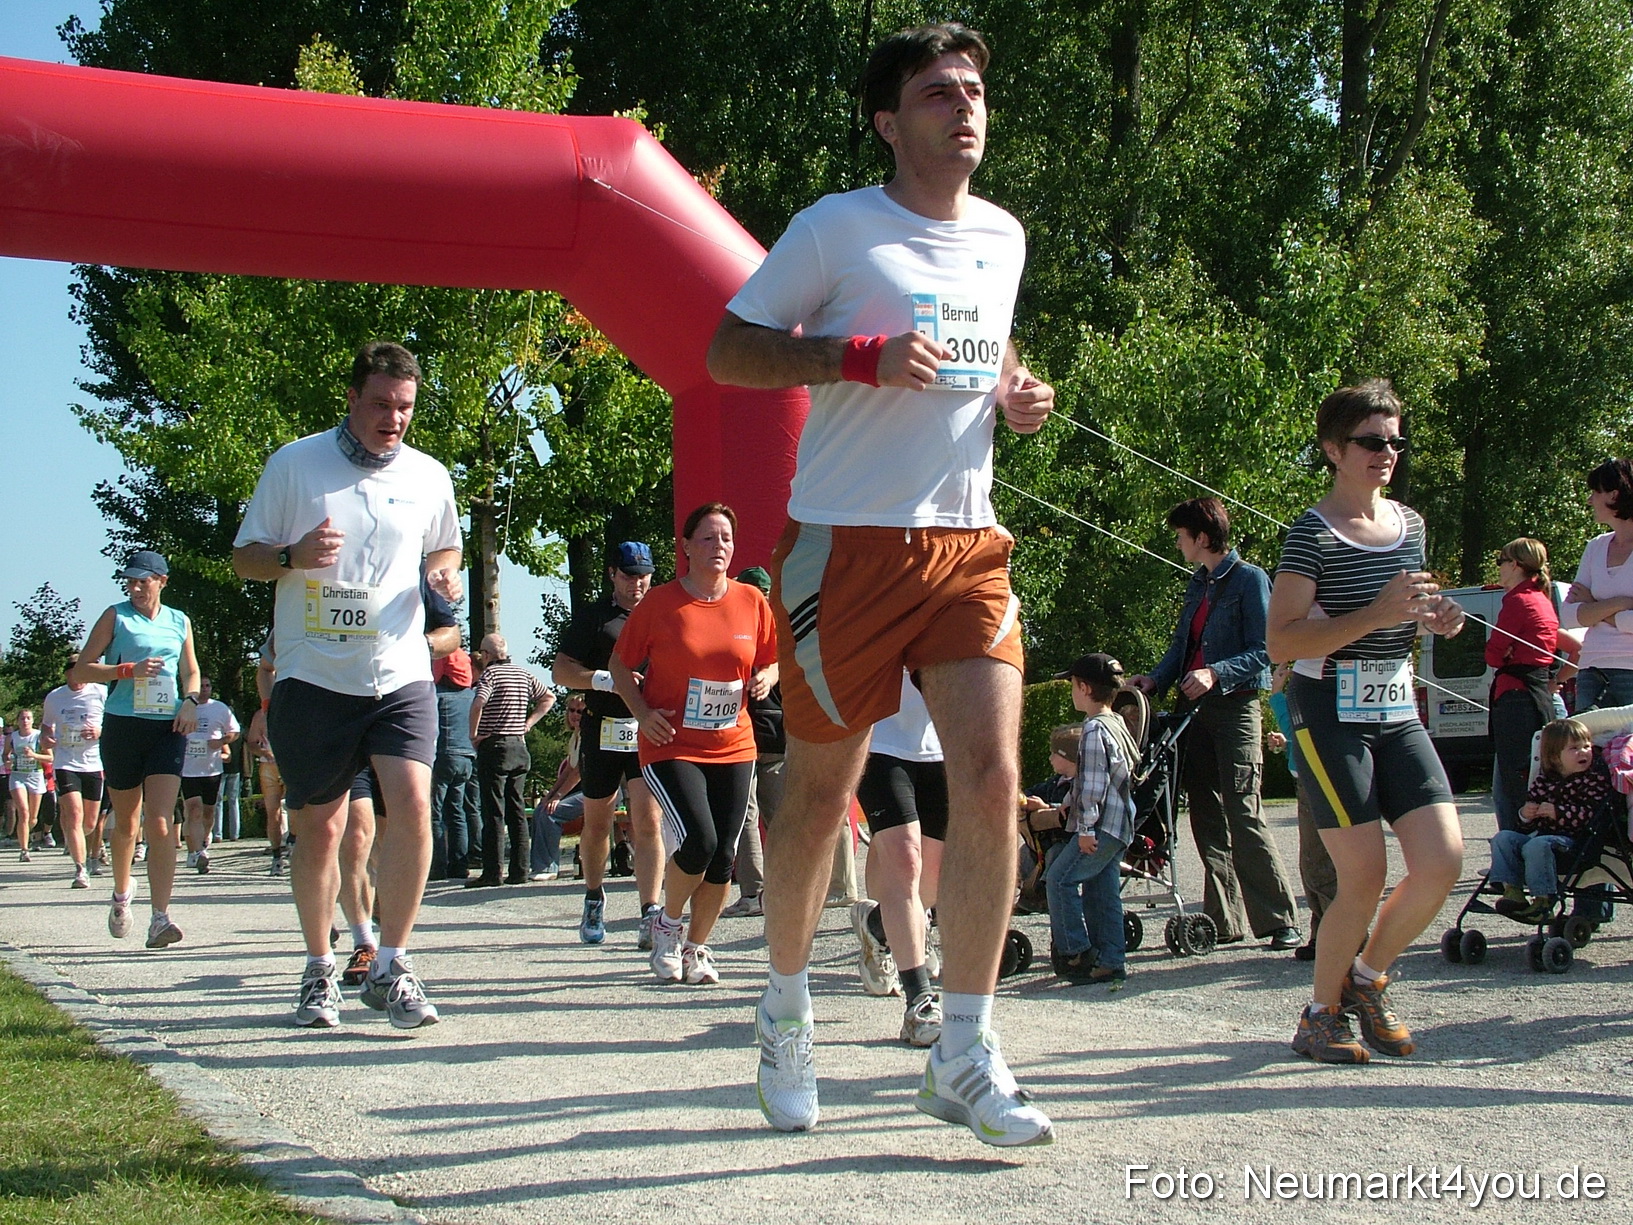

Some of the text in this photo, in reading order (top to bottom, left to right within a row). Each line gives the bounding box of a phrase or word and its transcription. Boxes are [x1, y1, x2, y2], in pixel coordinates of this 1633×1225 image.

[942, 303, 978, 322] Bernd
[946, 337, 999, 365] 3009
[322, 586, 368, 600] Christian
[330, 608, 367, 626] 708
[1361, 660, 1396, 674] Brigitte
[156, 692, 169, 703] 23
[704, 685, 733, 696] Martina
[1362, 683, 1406, 703] 2761
[703, 702, 738, 716] 2108
[619, 730, 638, 741] 38
